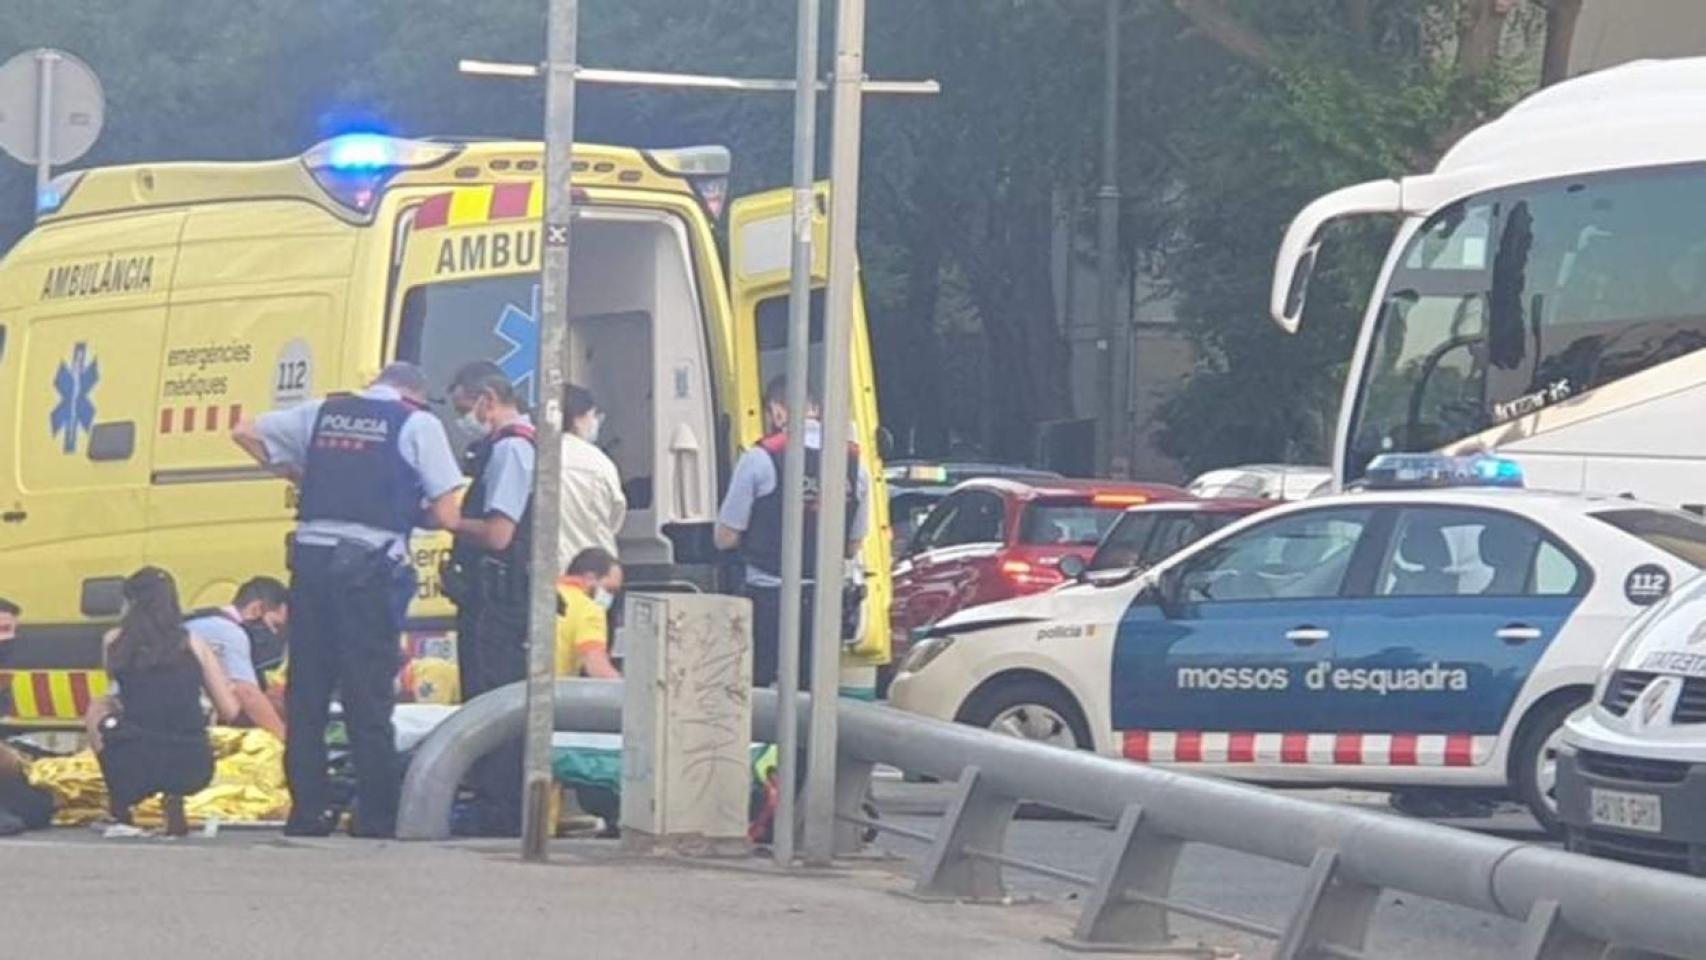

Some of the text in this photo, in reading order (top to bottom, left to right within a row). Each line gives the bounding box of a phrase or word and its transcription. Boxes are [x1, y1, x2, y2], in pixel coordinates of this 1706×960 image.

[277, 361, 306, 391] 112
[1630, 574, 1665, 590] 112
[1037, 625, 1082, 642] policia
[1178, 663, 1468, 695] mossos d'esquadra
